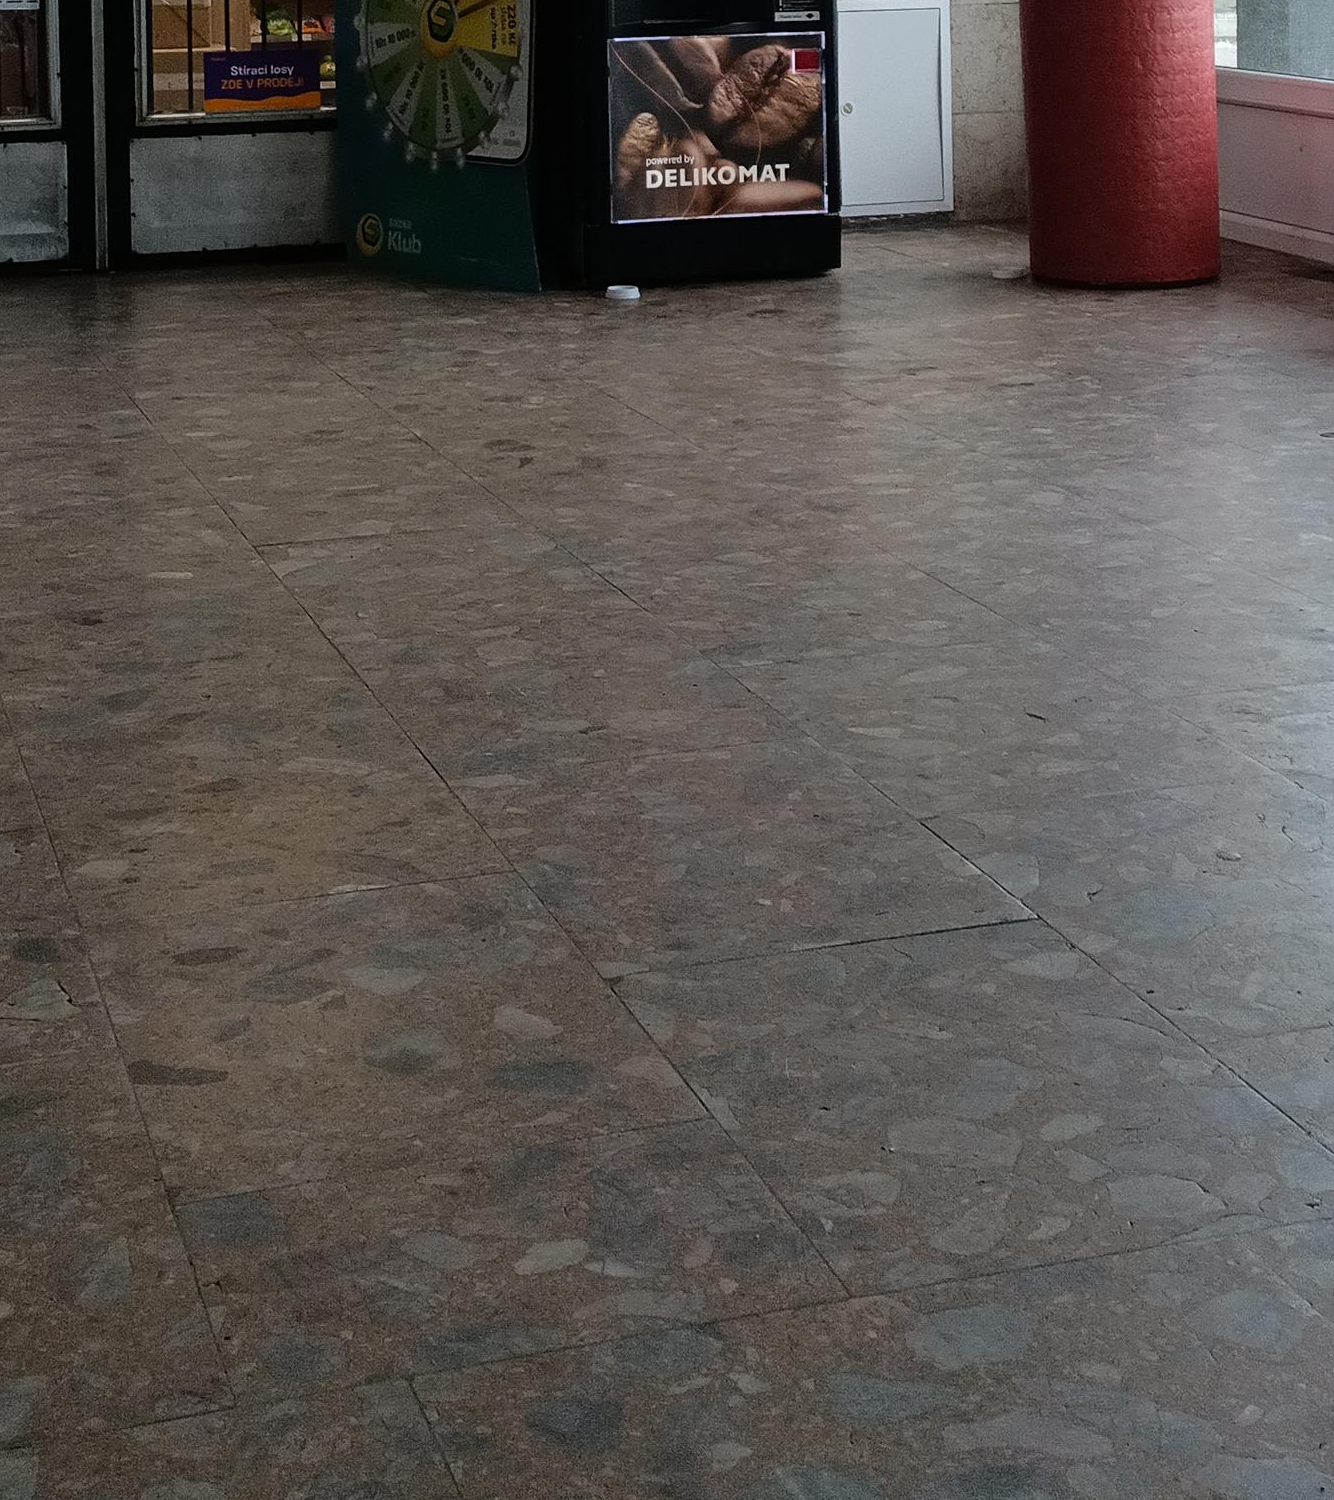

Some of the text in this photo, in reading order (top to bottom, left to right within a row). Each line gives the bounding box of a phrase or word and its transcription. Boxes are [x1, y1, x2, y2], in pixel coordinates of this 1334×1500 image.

[270, 64, 294, 76] losy
[220, 79, 244, 90] ZDE
[246, 79, 255, 89] V
[645, 154, 695, 167] powered by
[645, 162, 791, 190] DELIKOMAT
[387, 230, 423, 255] Klub
